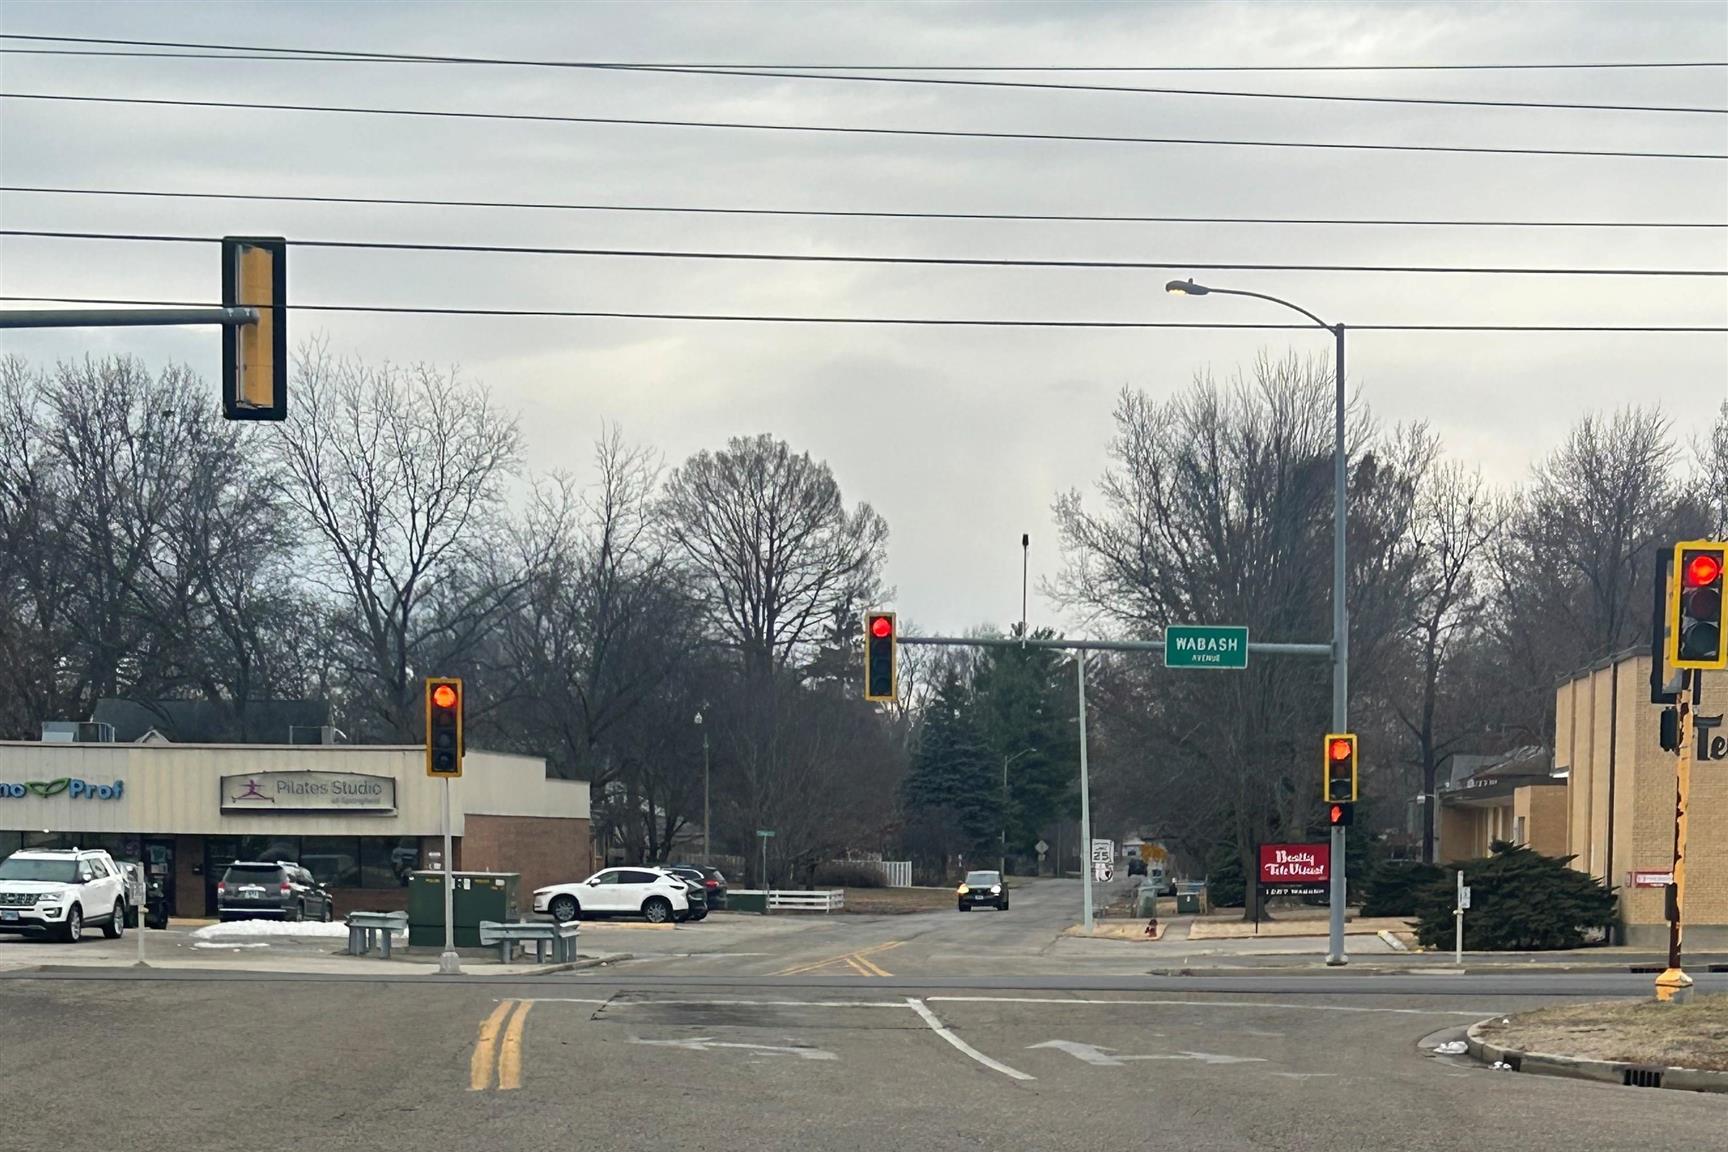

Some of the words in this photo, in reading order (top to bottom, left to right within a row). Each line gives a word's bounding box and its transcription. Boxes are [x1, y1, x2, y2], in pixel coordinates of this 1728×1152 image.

[1175, 637, 1238, 651] WABASH
[1191, 654, 1221, 662] AVENUE
[69, 779, 124, 800] Prof
[276, 780, 328, 795] Pilates
[331, 780, 382, 795] Studio
[1093, 851, 1109, 861] 25
